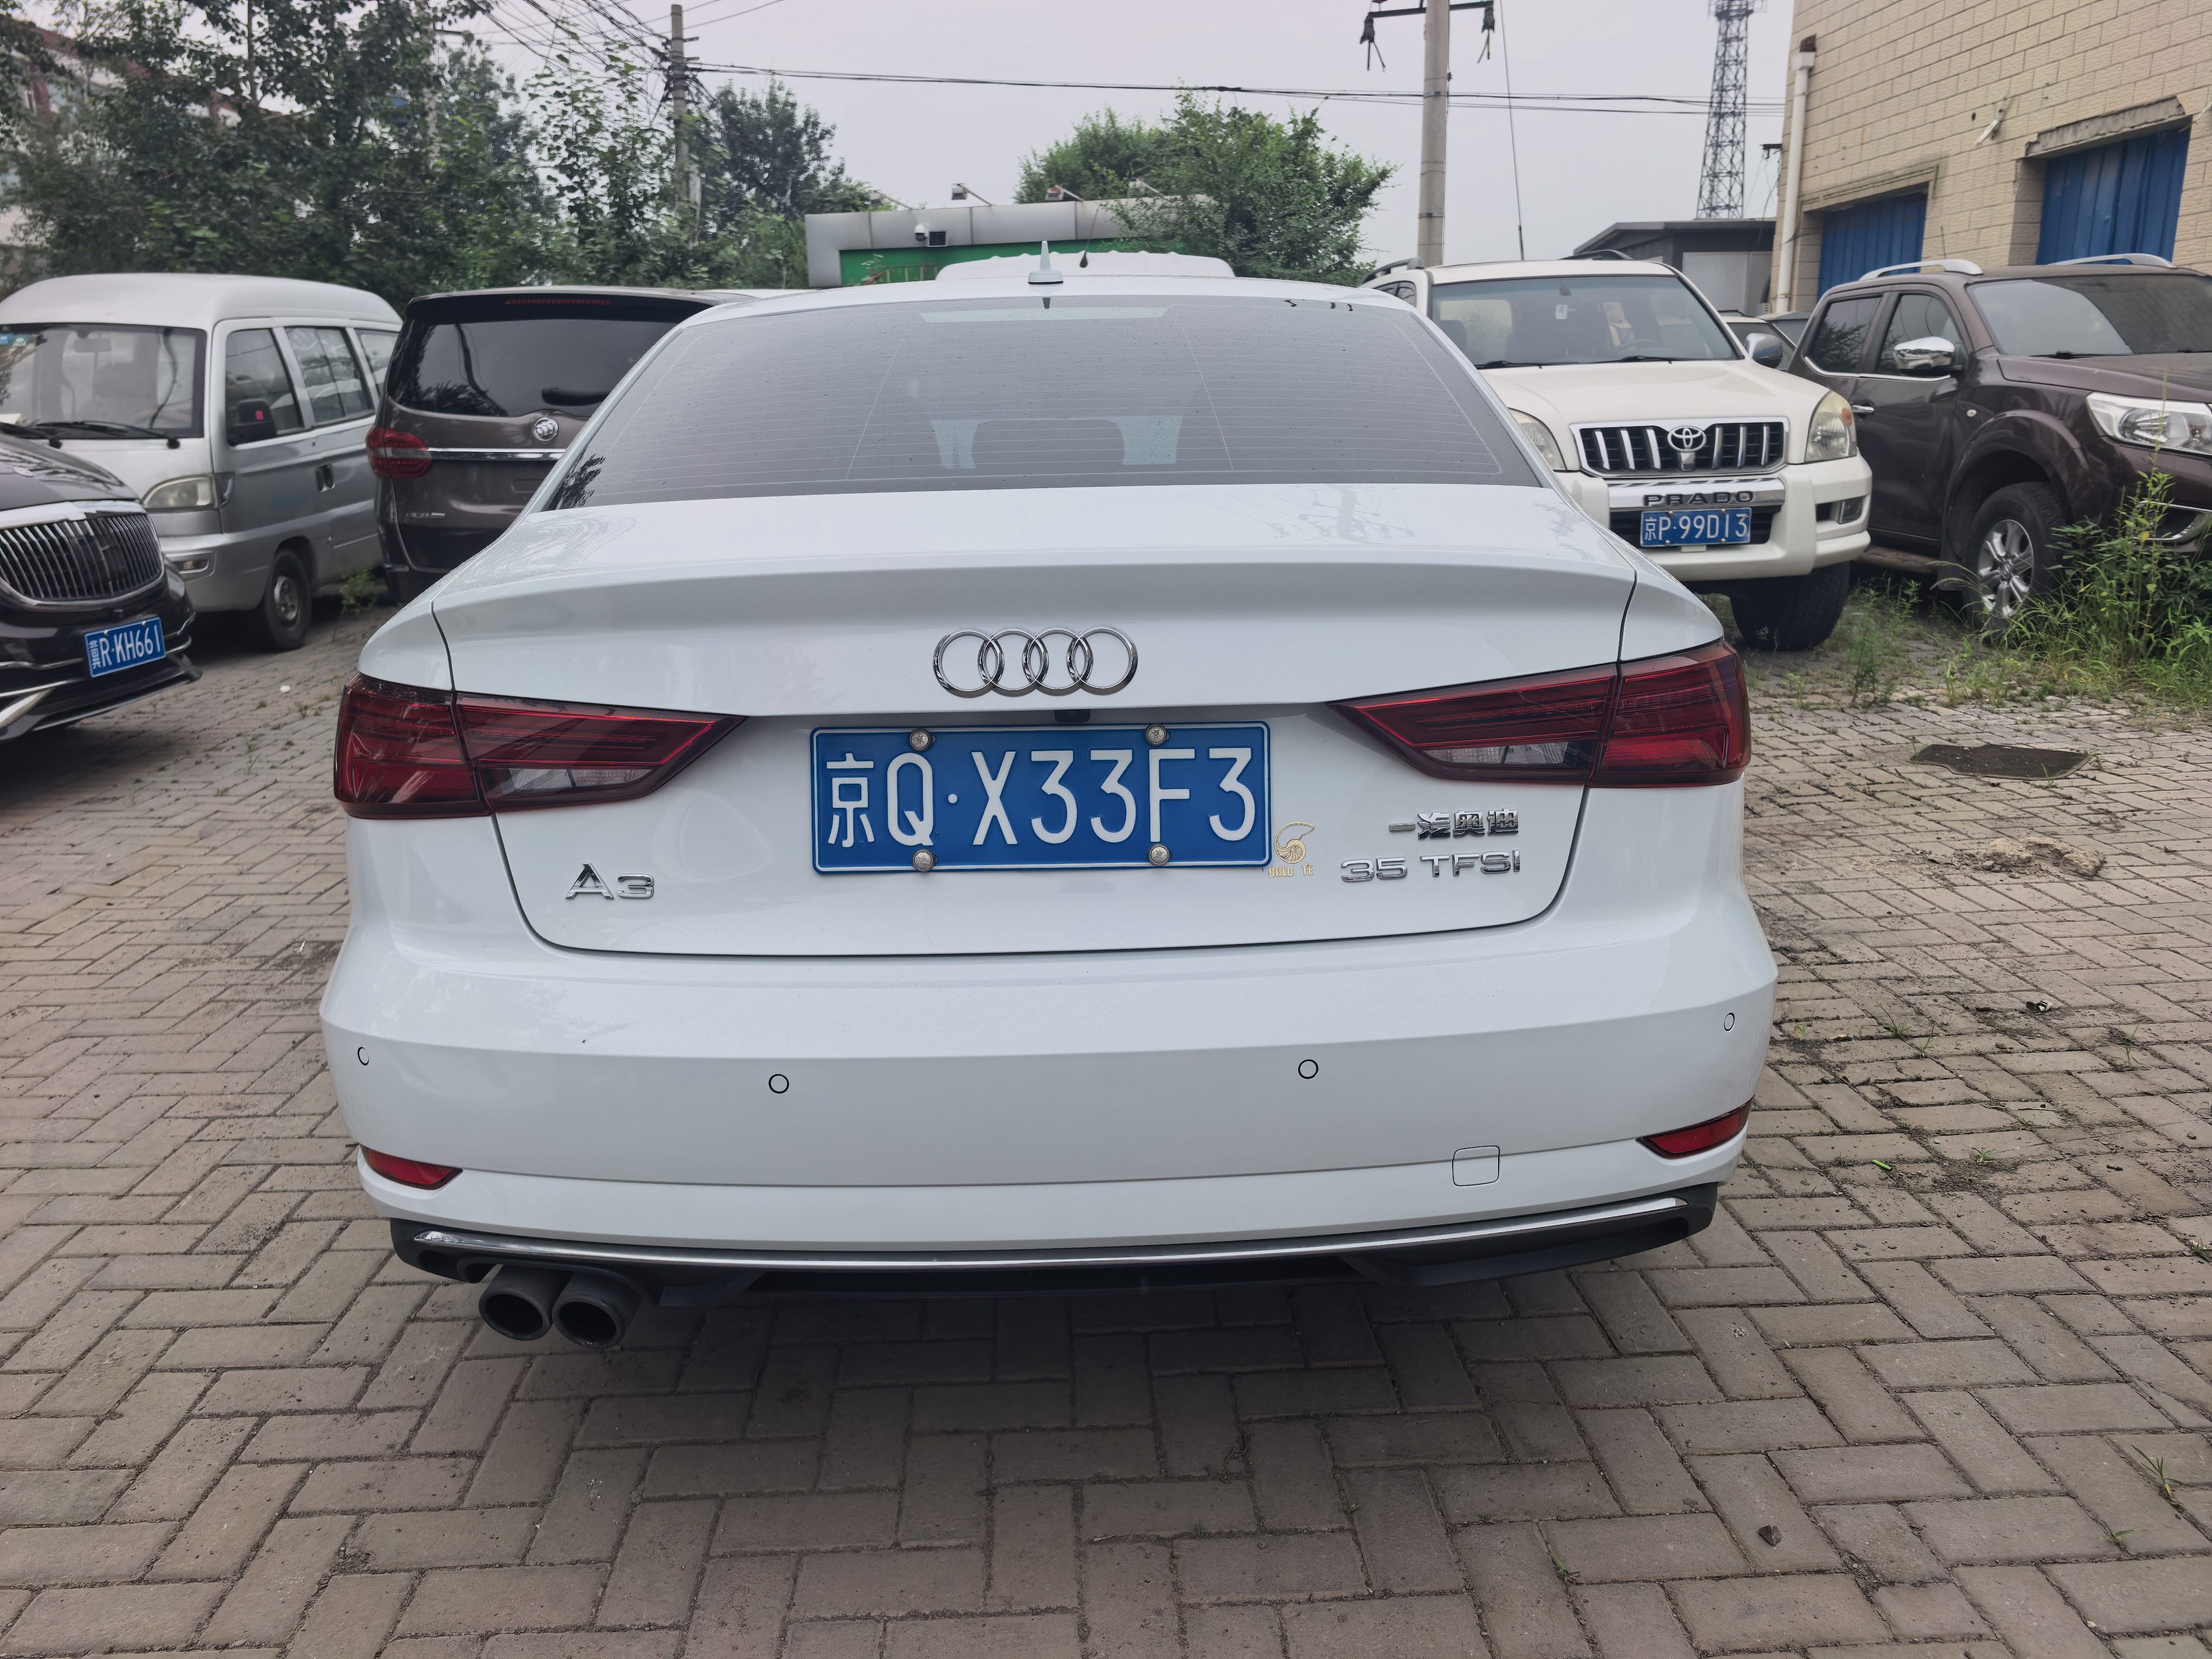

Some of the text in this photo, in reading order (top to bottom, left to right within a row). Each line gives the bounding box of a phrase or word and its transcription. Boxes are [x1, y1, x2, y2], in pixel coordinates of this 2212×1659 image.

[1644, 490, 1754, 506] PRADO
[826, 747, 1255, 847] 京Q·X33F3
[1389, 808, 1519, 840] 一汽奥迪
[565, 862, 655, 899] A3
[1341, 849, 1520, 882] 35 TFSI
